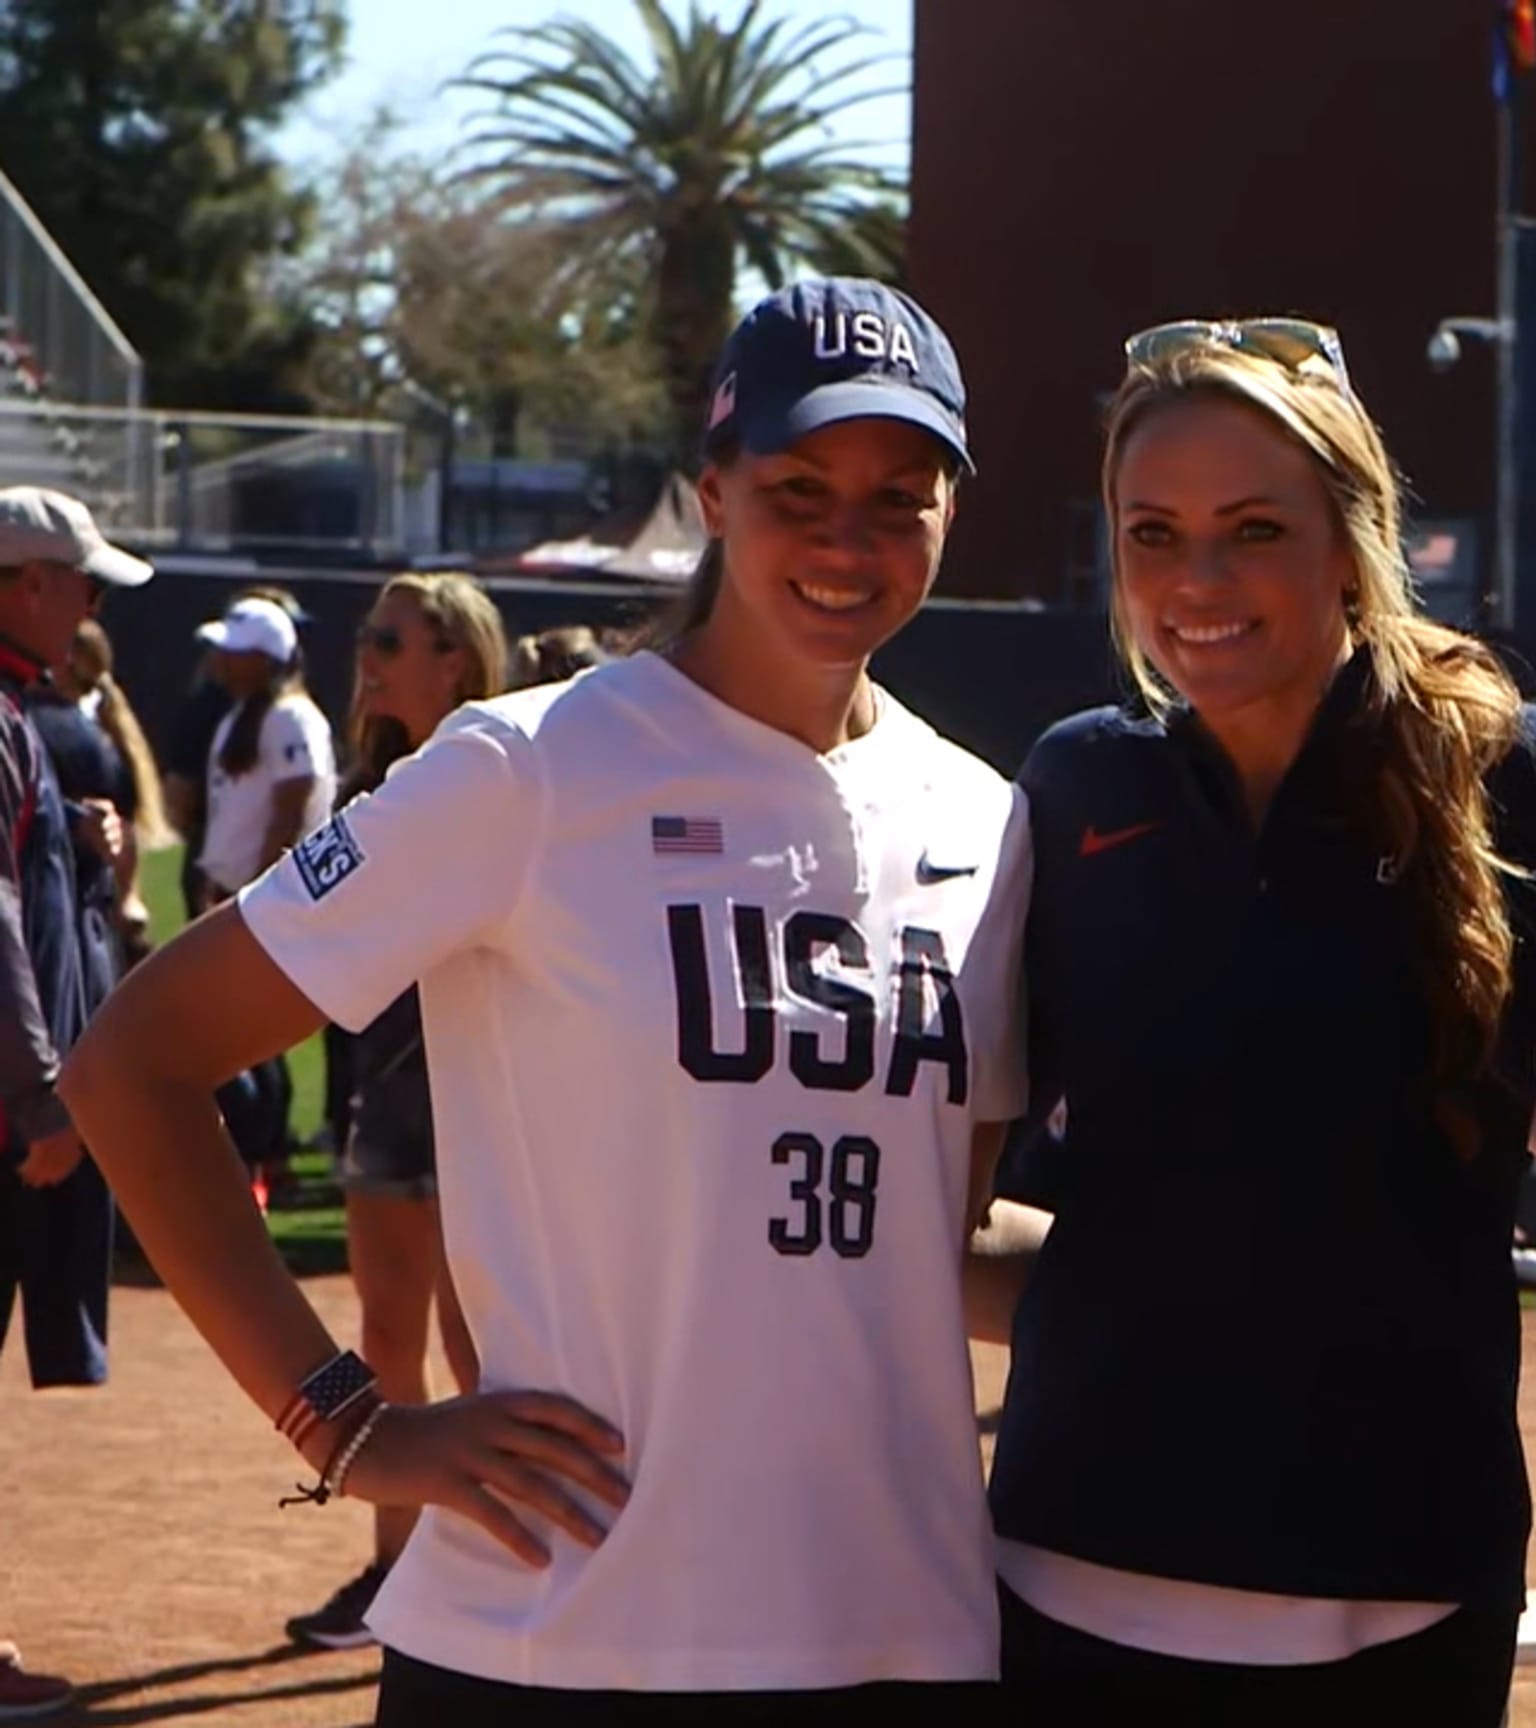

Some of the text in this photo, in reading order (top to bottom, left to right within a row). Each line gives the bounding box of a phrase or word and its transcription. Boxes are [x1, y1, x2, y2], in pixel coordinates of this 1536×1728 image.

[814, 312, 920, 373] USA
[666, 902, 969, 1107] USA
[768, 1132, 881, 1259] 38
